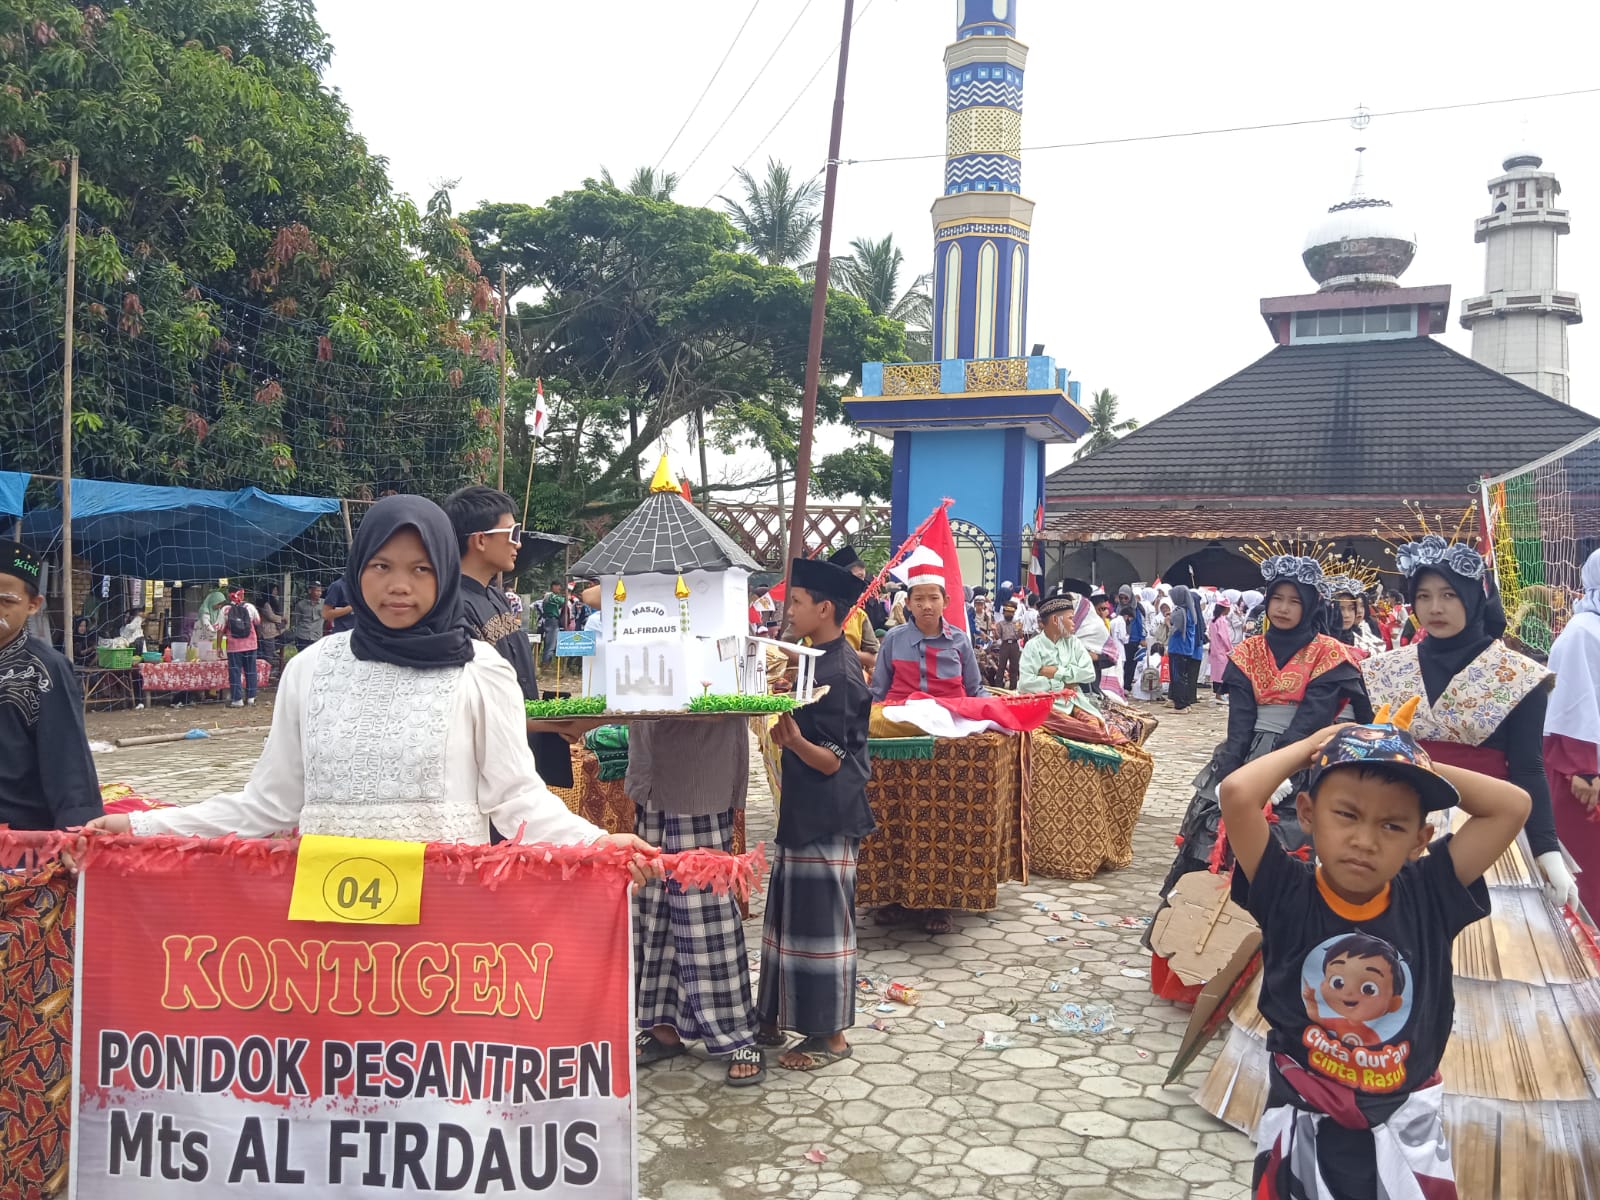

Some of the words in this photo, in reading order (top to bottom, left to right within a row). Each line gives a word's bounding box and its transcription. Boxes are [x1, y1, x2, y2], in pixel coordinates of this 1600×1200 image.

[632, 606, 665, 616] MASJID
[623, 625, 676, 635] AL-FIRDAUS
[336, 876, 382, 910] 04
[161, 935, 554, 1021] KONTIGEN
[732, 1048, 760, 1063] RICH
[1306, 1027, 1349, 1063] Cinta
[1355, 1043, 1408, 1069] Qur'an
[99, 1030, 309, 1096] PONDOK
[322, 1040, 612, 1105] PESANTREN
[1363, 1062, 1405, 1088] Rasul
[108, 1109, 209, 1183] Mts
[227, 1115, 305, 1185] AL
[328, 1119, 600, 1194] FIRDAUS
